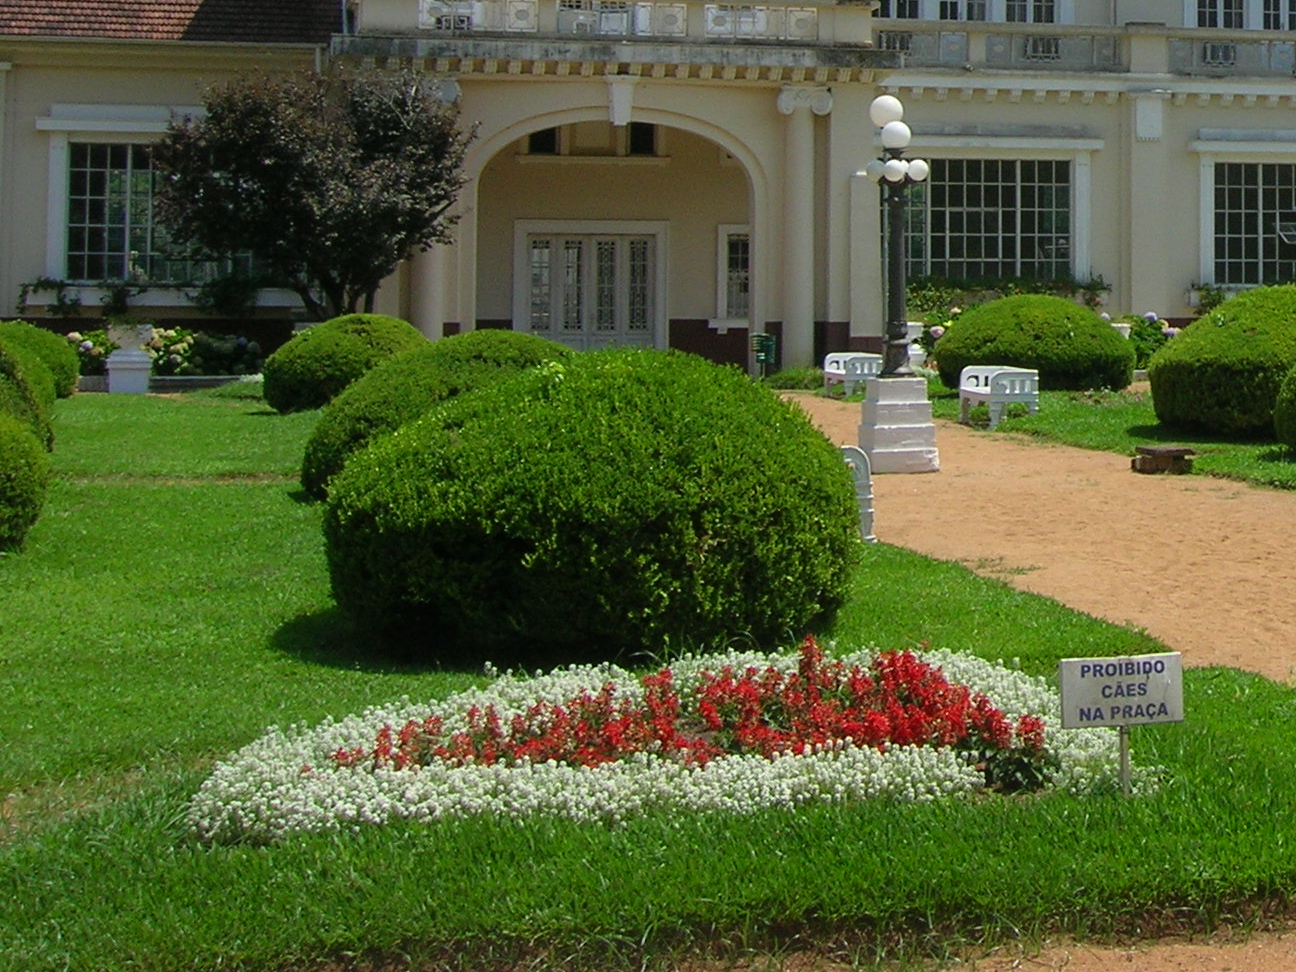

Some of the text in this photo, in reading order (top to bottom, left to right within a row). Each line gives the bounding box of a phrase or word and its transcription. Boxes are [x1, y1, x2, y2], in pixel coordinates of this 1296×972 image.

[1081, 660, 1165, 678] PROIBIDO
[1101, 681, 1147, 698] CÃES
[1079, 702, 1168, 721] NA PRAÇA
